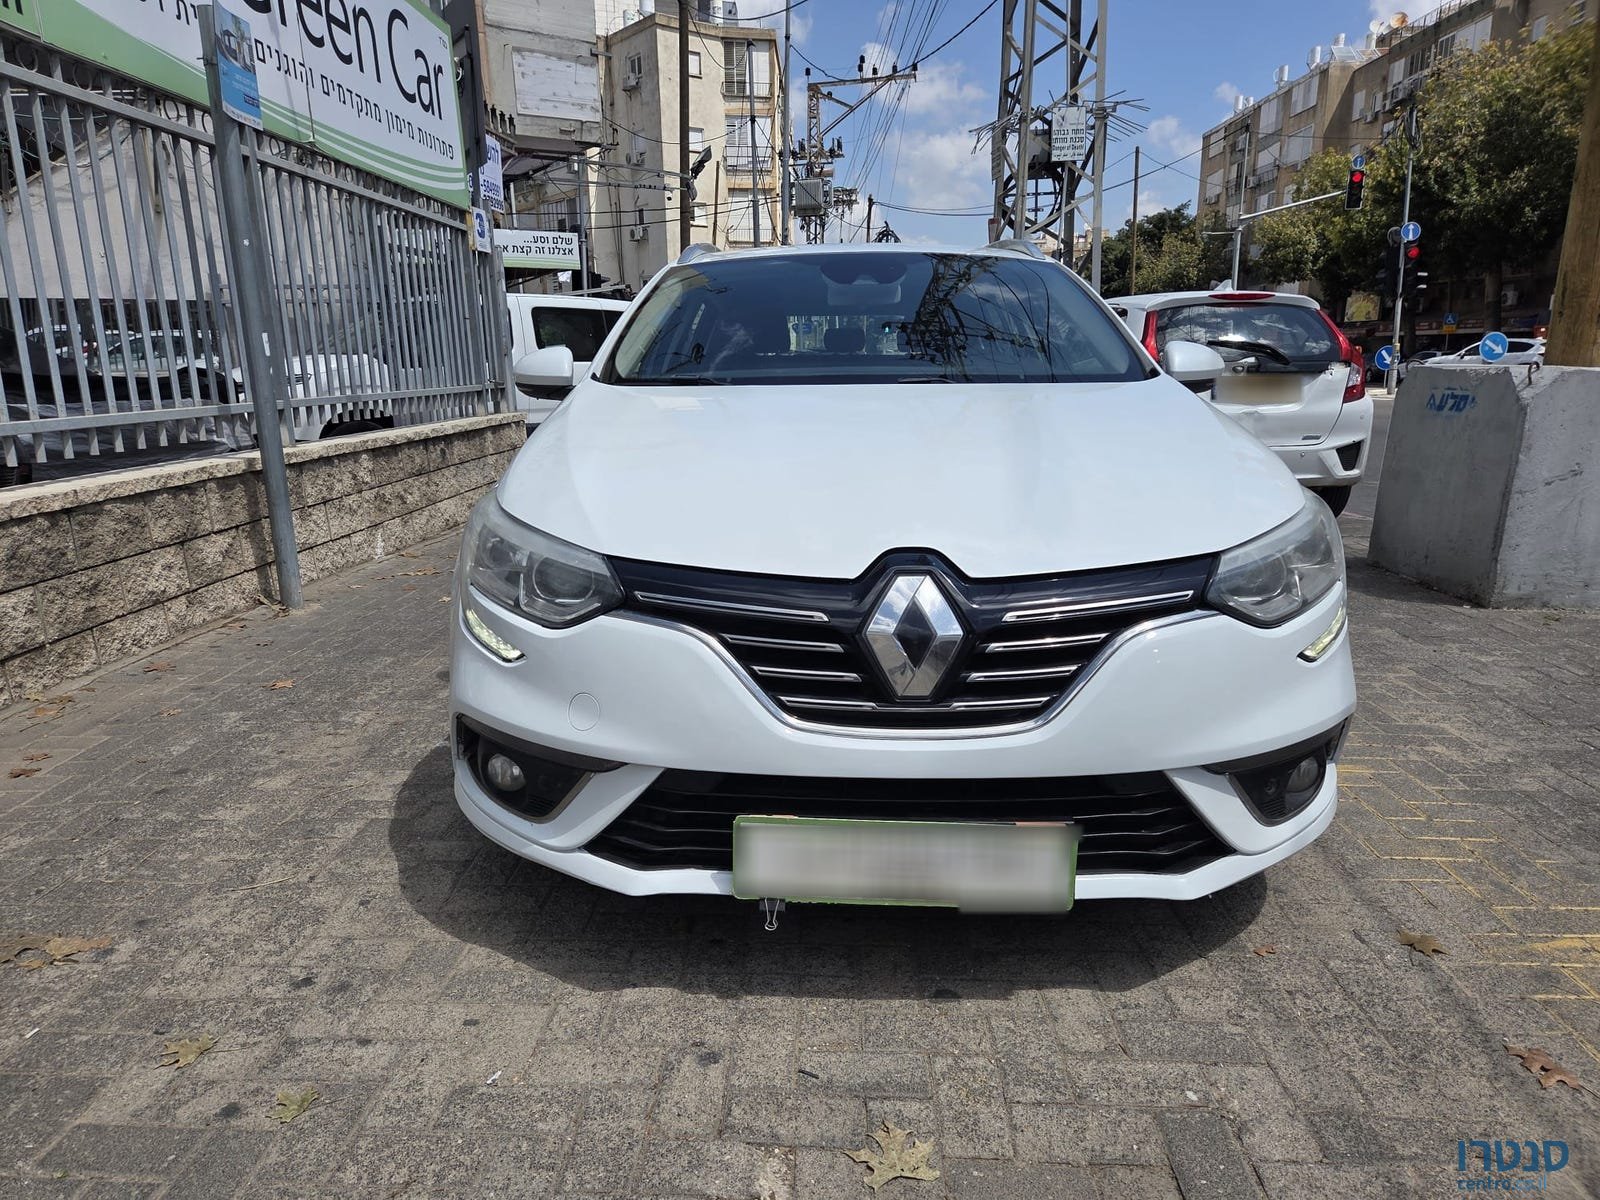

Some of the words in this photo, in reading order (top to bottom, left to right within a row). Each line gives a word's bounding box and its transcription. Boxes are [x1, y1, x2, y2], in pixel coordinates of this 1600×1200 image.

[243, 0, 381, 84] een
[387, 8, 443, 120] Car
[253, 37, 315, 89] והוגנים
[320, 73, 382, 123] מתקדמים
[385, 109, 414, 140] מימון
[417, 126, 454, 160] פתרונות
[523, 235, 550, 244] וסע...
[552, 234, 573, 246] שלם
[512, 245, 532, 256] קצת
[535, 246, 546, 255] זה
[548, 245, 574, 256] אצלנו
